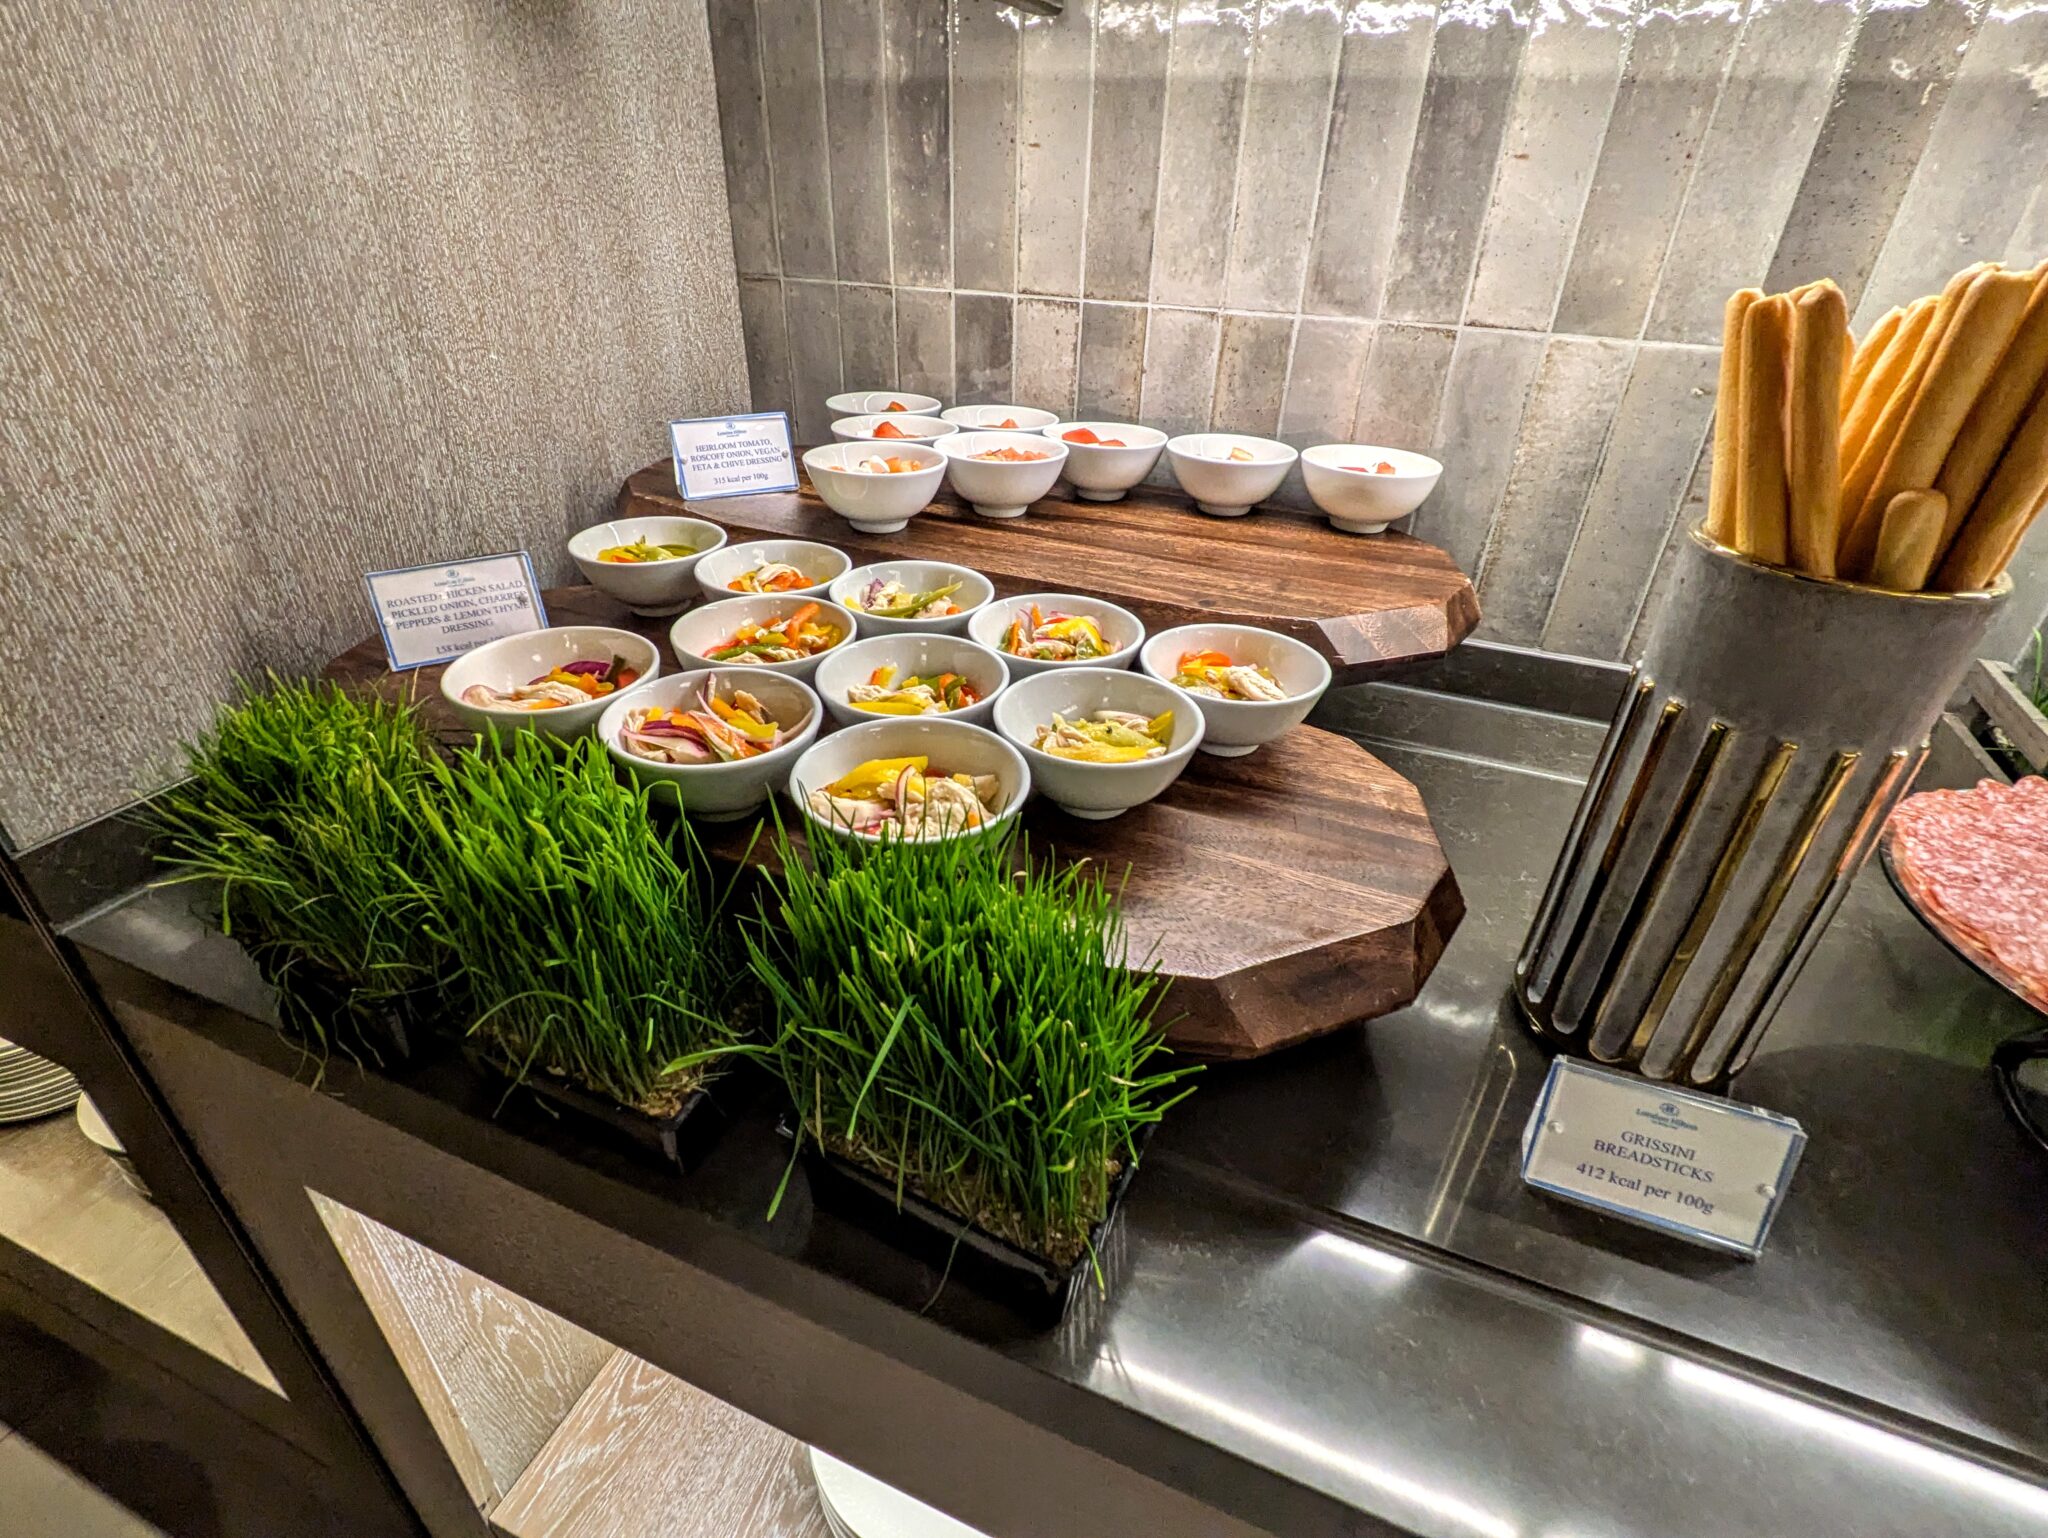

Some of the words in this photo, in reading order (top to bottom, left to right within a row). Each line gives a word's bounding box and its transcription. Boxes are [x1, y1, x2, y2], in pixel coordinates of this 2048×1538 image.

[696, 442, 736, 452] HEIRLOOM
[737, 439, 772, 448] TOMATO,
[691, 454, 724, 462] ROSCOFF
[726, 450, 753, 460] ONION,
[754, 447, 780, 455] VEGAN
[692, 462, 712, 471] FETA
[721, 460, 745, 468] CHIVE
[746, 456, 782, 466] DRESSING
[727, 474, 740, 483] kcal
[742, 475, 752, 483] per
[387, 595, 437, 608] ROASTED
[392, 606, 437, 619] PICKLED
[440, 599, 477, 611] ONION,
[396, 616, 442, 630] PEPPERS
[454, 608, 491, 620] LEMON
[494, 602, 530, 613] THYME
[442, 619, 494, 634] DRESSING
[454, 642, 472, 650] kcal
[1621, 1131, 1696, 1161] GRISSINI
[1593, 1139, 1714, 1183] BREADSTICKS
[1576, 1163, 1604, 1180] 412
[1608, 1174, 1641, 1191] kcal
[1643, 1184, 1671, 1200] per
[1676, 1191, 1714, 1215] 100g
